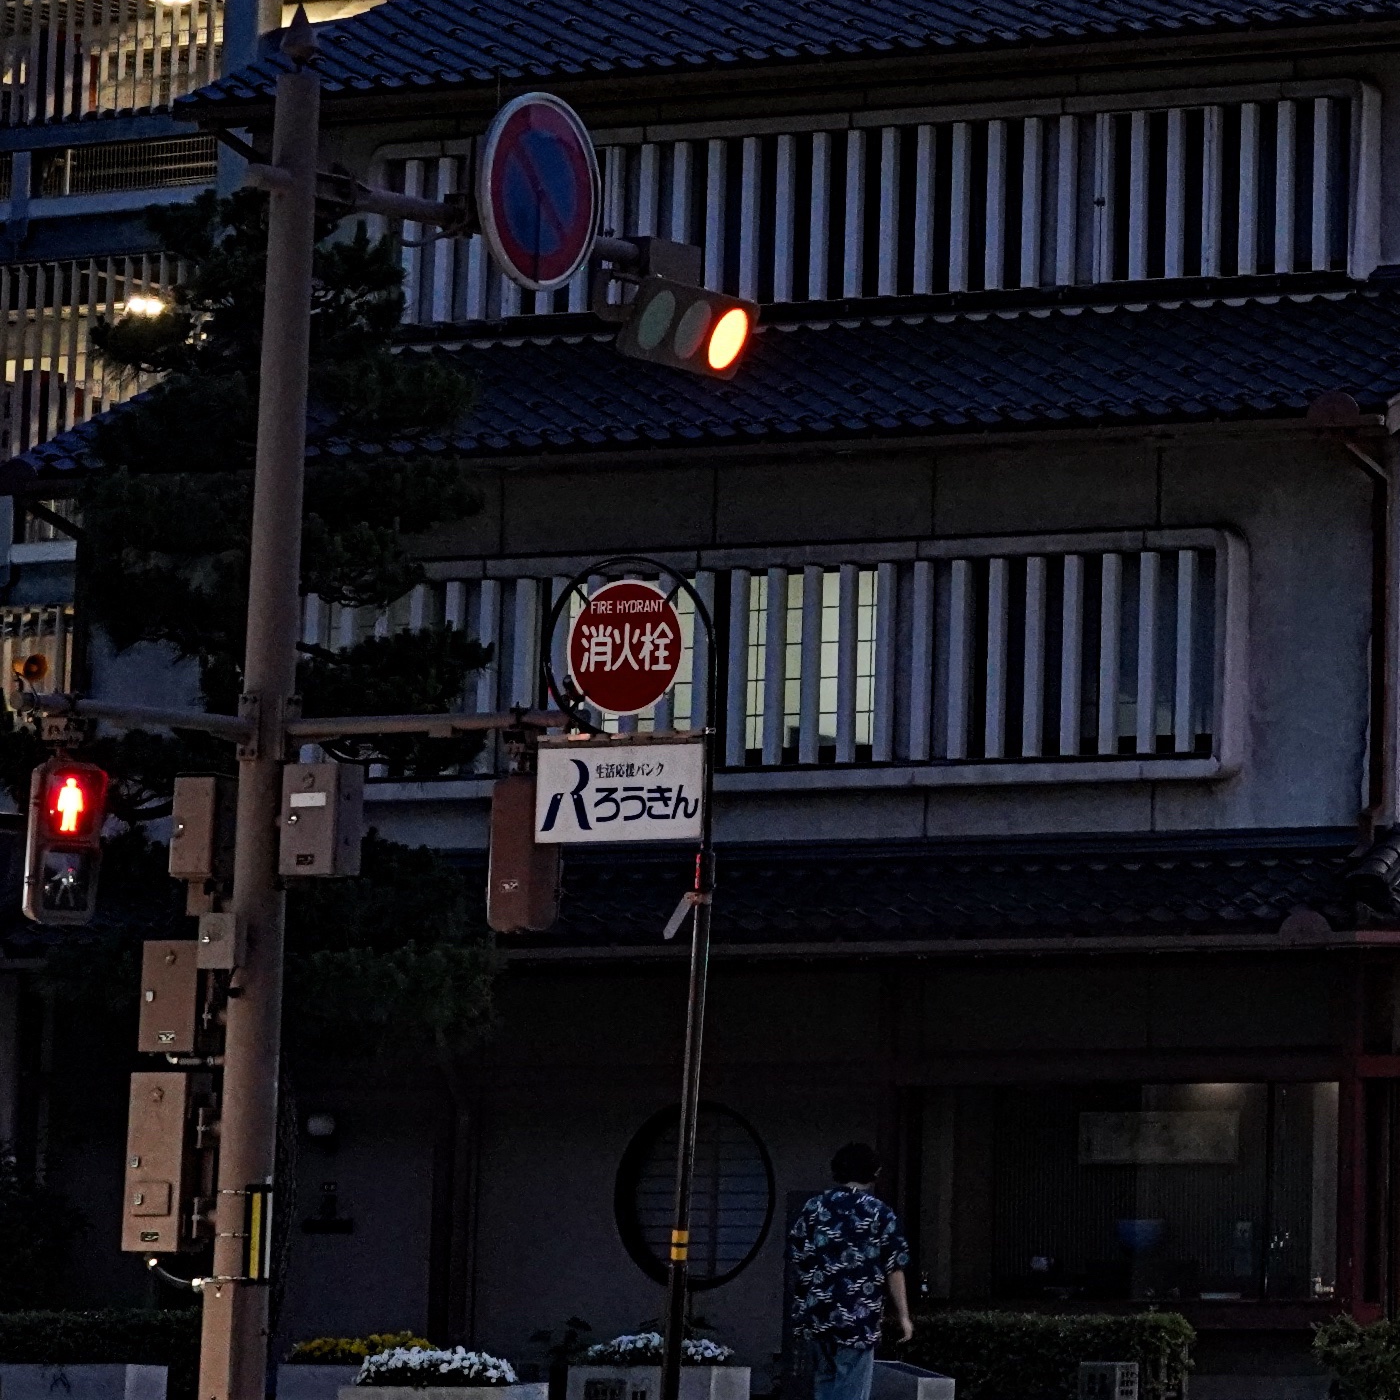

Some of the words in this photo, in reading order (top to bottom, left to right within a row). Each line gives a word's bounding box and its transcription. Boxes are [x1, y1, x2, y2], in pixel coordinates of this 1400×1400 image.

[590, 601, 613, 614] FIRE
[616, 599, 664, 614] HYDRANT
[580, 622, 674, 673] 消火栓
[595, 762, 664, 779] 生活応援バンク
[594, 784, 699, 823] ろうきん
